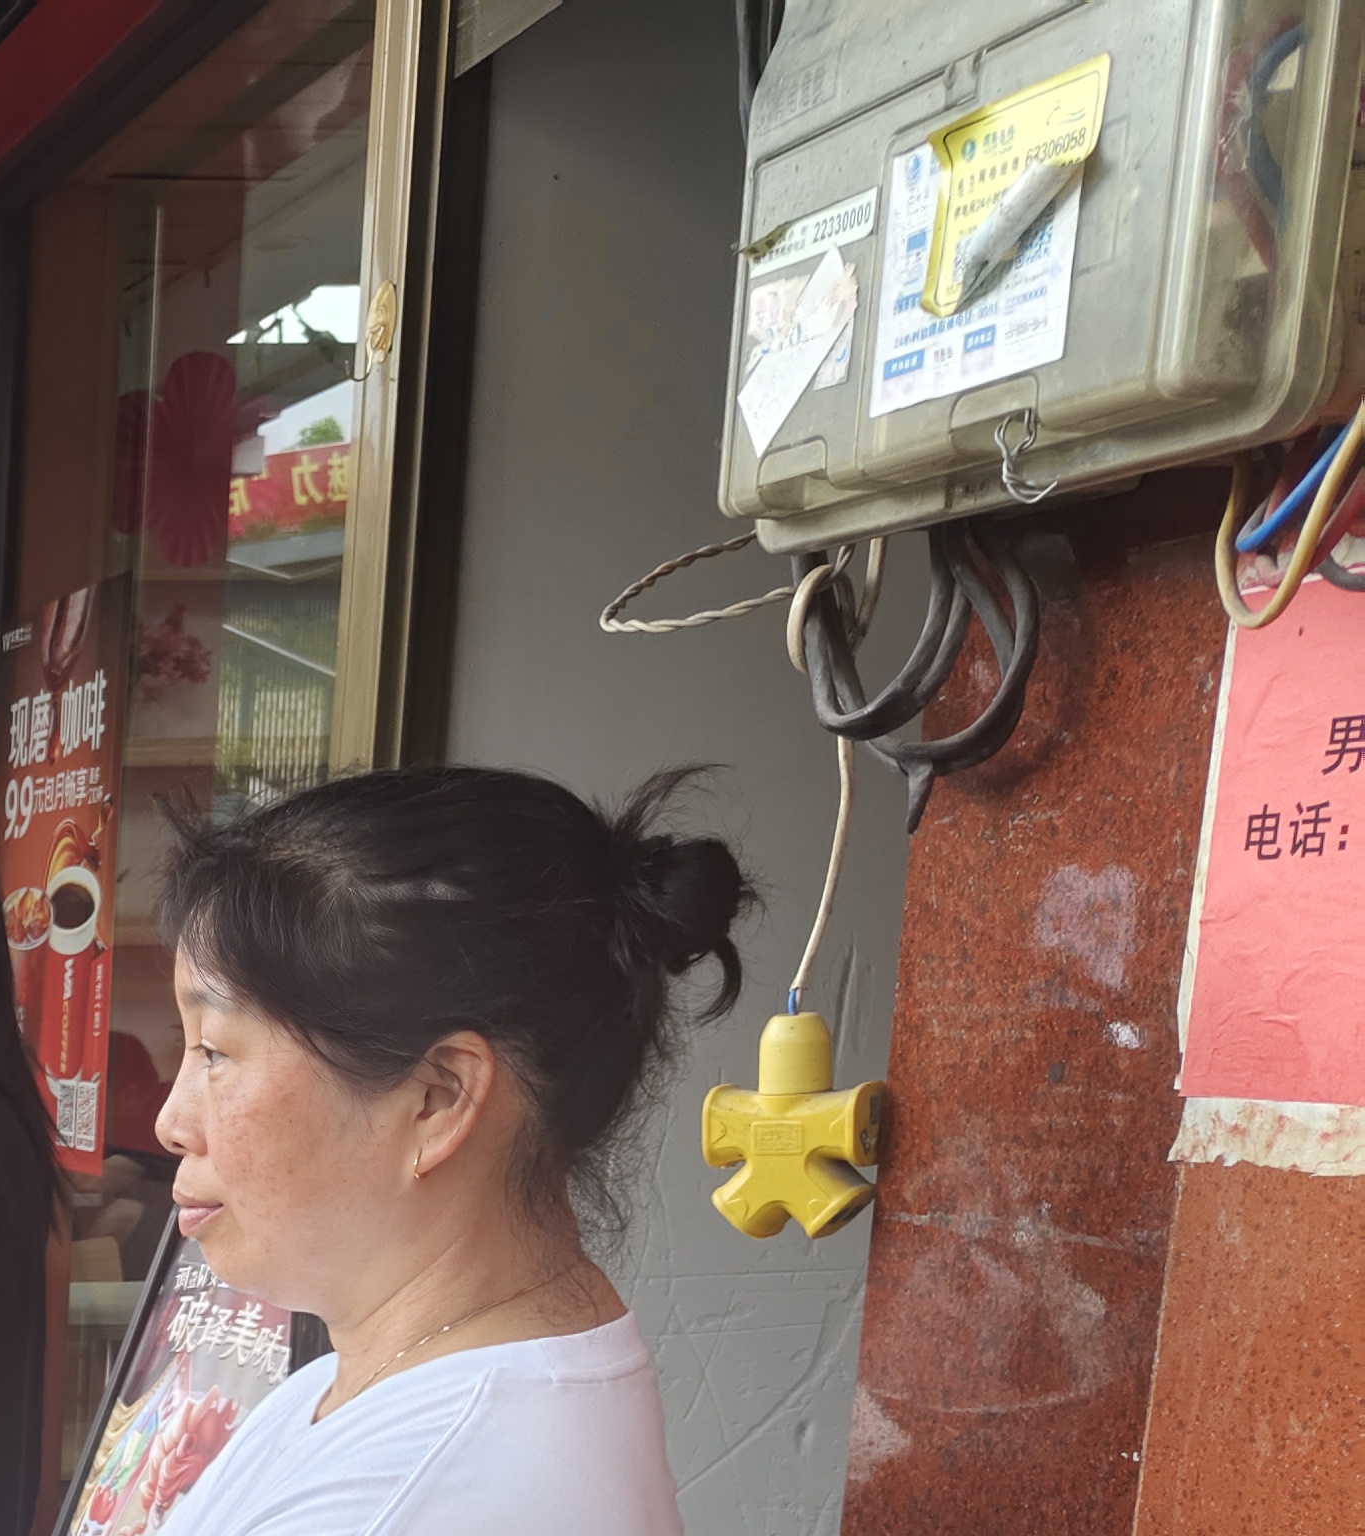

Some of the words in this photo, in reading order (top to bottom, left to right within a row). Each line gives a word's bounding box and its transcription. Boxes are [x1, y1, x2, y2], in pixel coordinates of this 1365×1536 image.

[812, 200, 872, 243] 22330000
[8, 688, 53, 769] 现磨
[59, 668, 108, 758] 咖啡
[1244, 800, 1350, 861] 电话：
